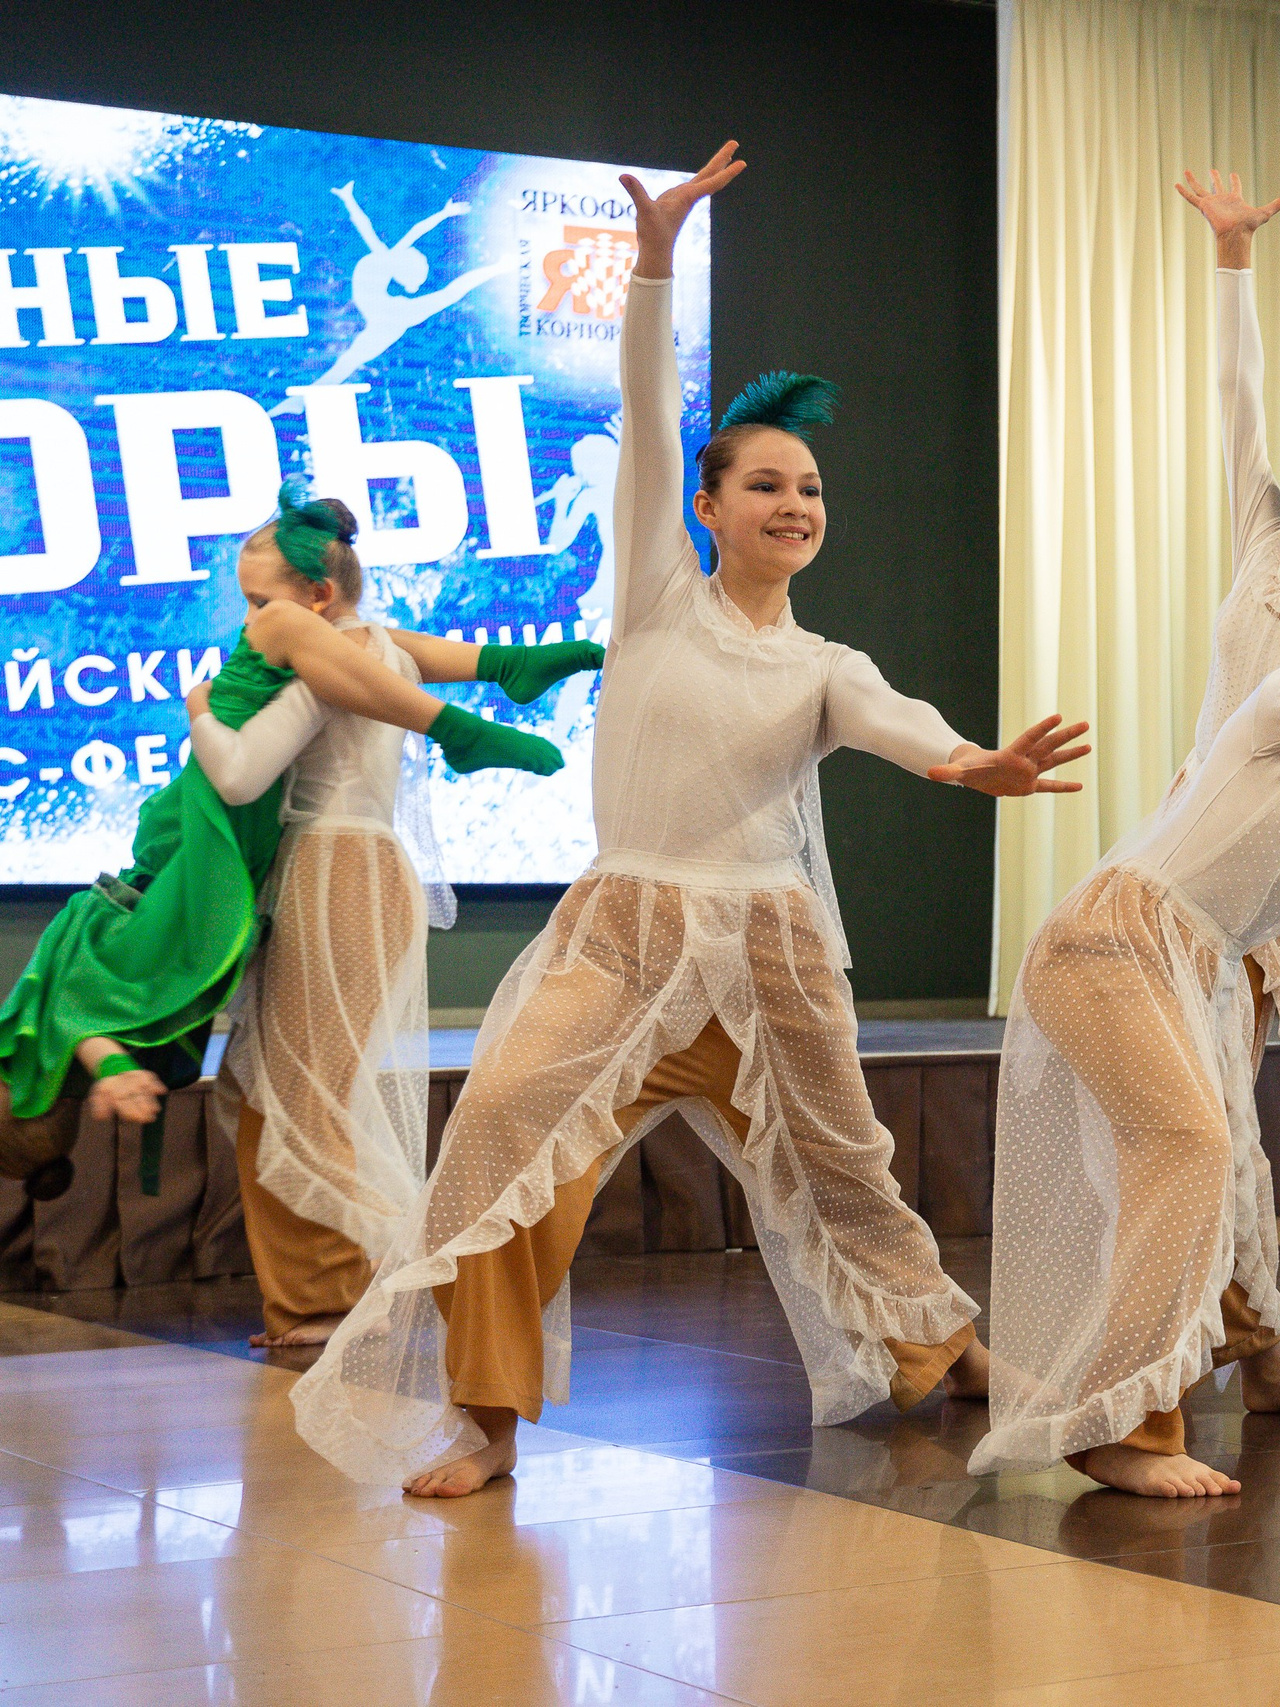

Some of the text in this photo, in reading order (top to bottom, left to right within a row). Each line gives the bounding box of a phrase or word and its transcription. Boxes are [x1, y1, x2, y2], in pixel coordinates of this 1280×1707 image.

[0, 242, 309, 348] НЫЕ
[4, 646, 223, 712] ЙСКИ
[0, 734, 192, 801] С-ФЕ
